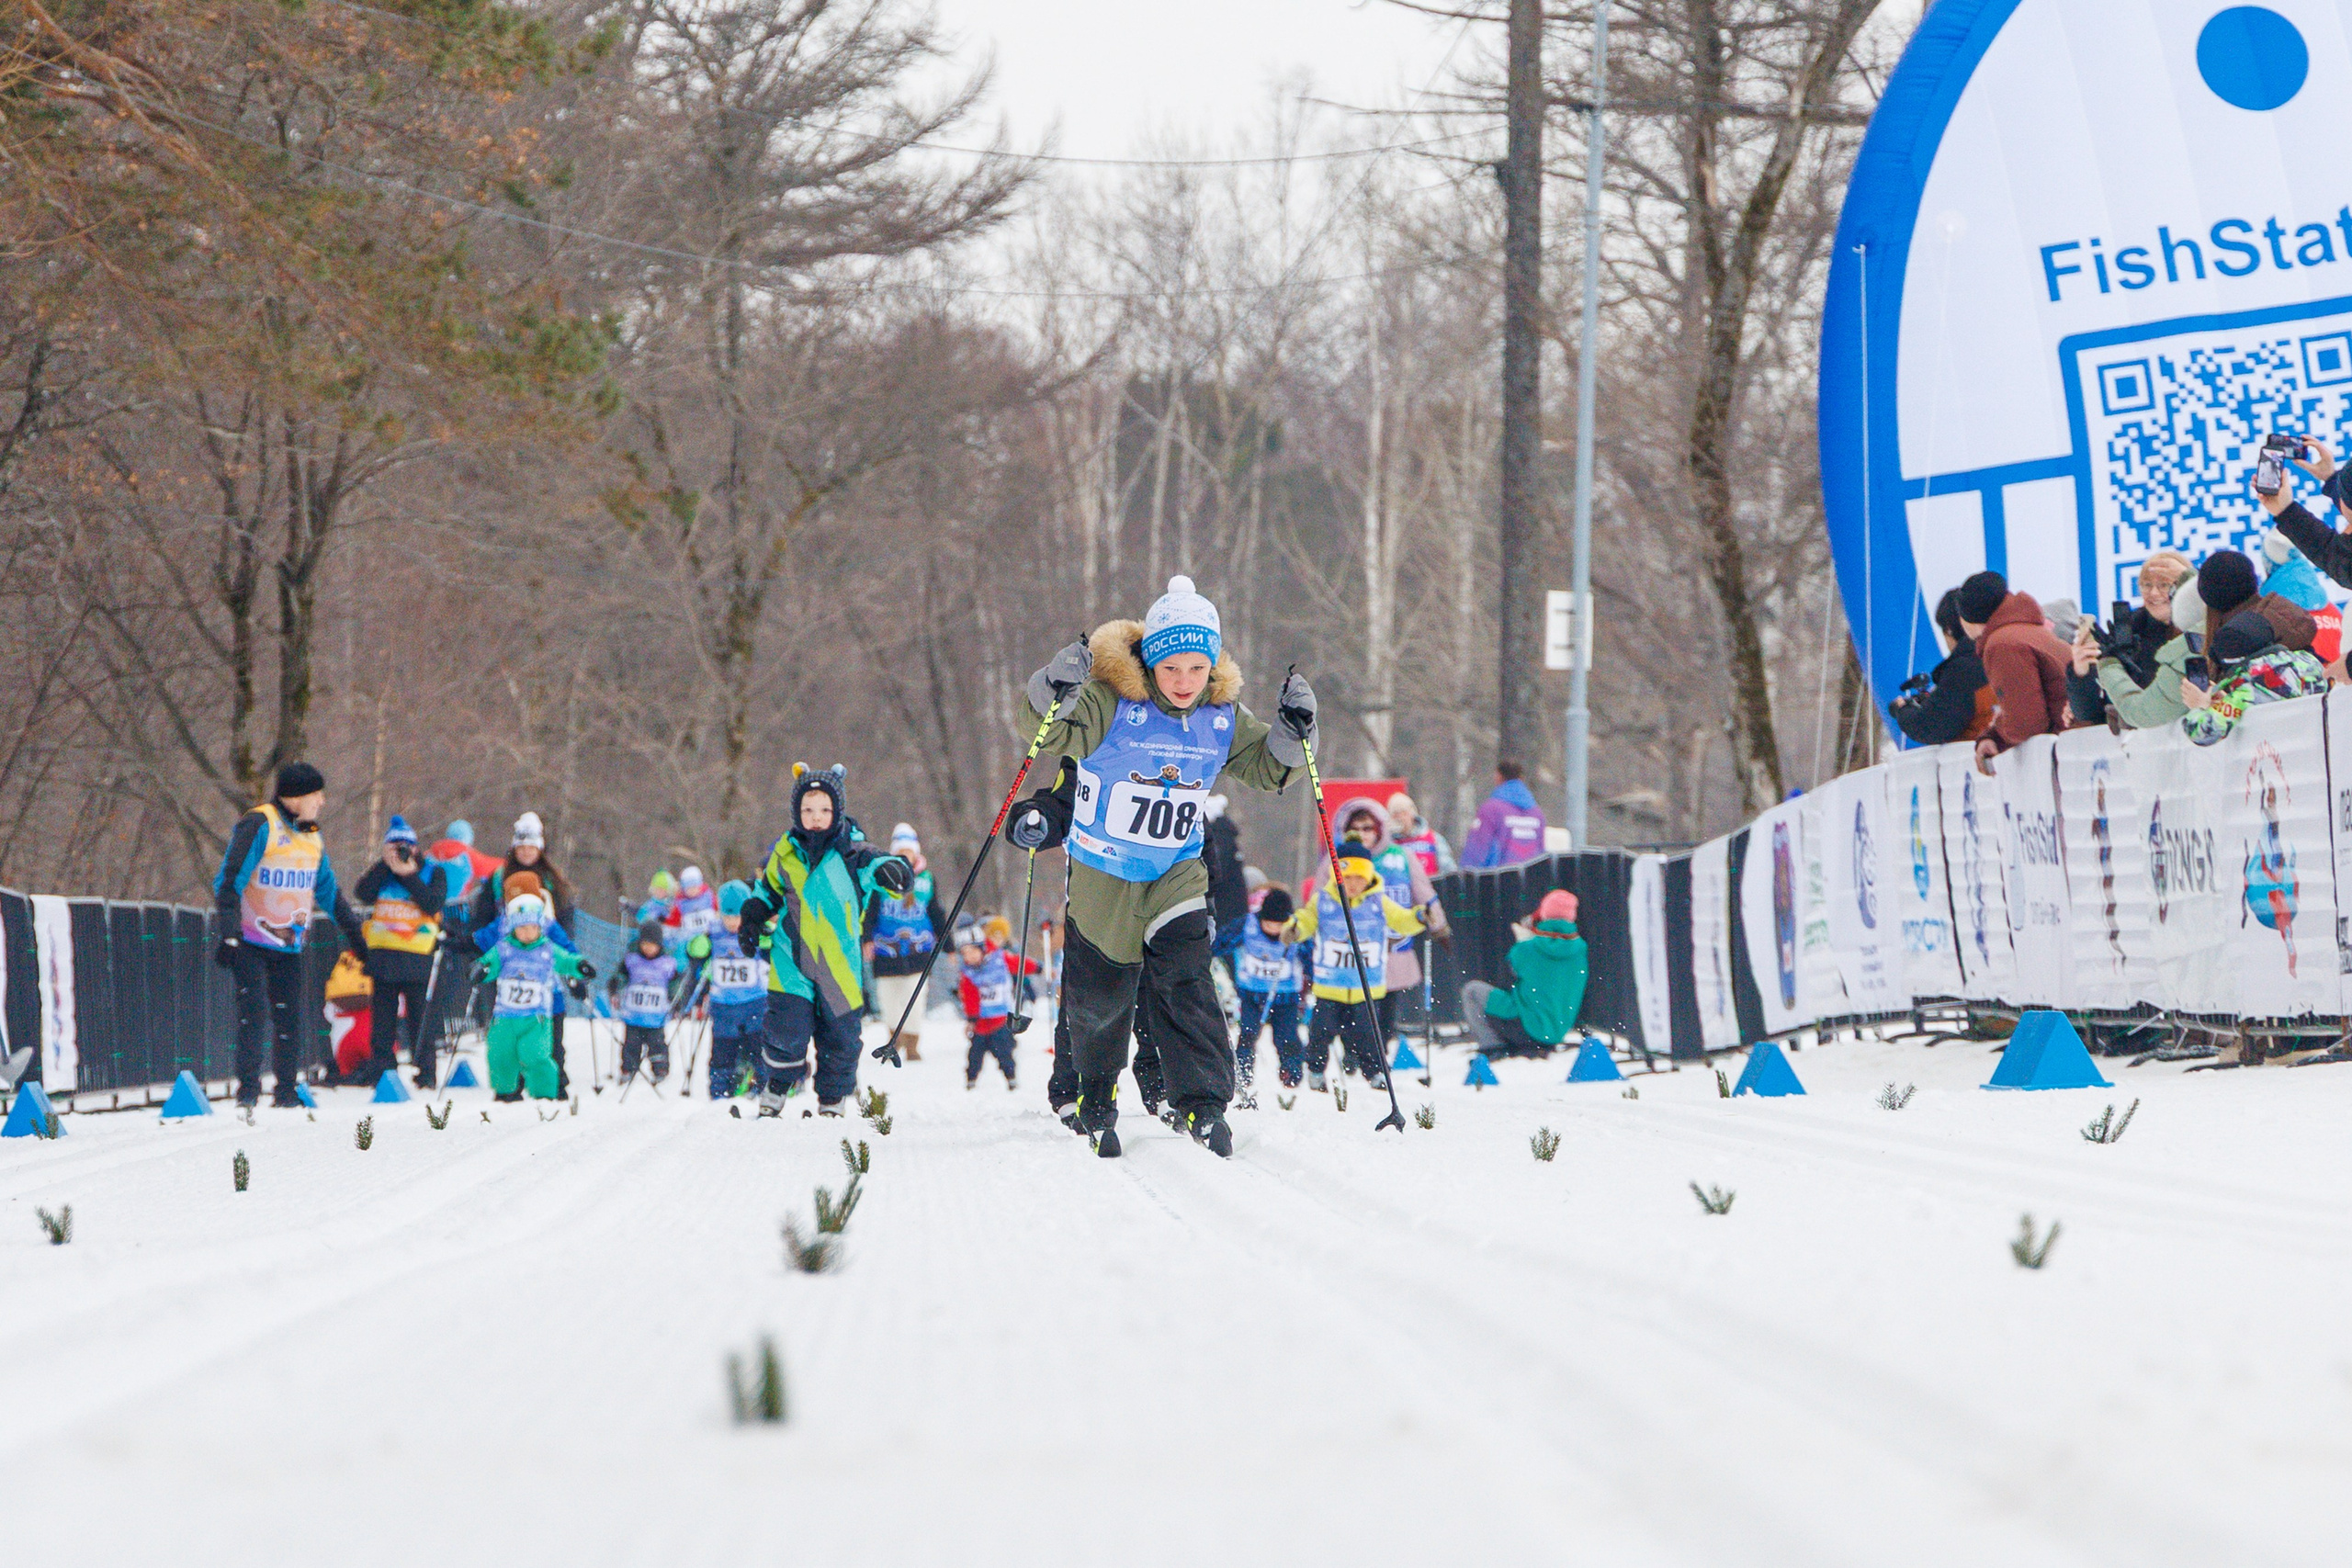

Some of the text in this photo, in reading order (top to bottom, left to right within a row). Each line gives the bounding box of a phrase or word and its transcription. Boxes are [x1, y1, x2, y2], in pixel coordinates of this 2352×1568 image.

[2313, 615, 2342, 630] SSIA
[1148, 632, 1204, 656] РОССИИ
[1127, 795, 1197, 841] 708
[719, 964, 748, 983] 726
